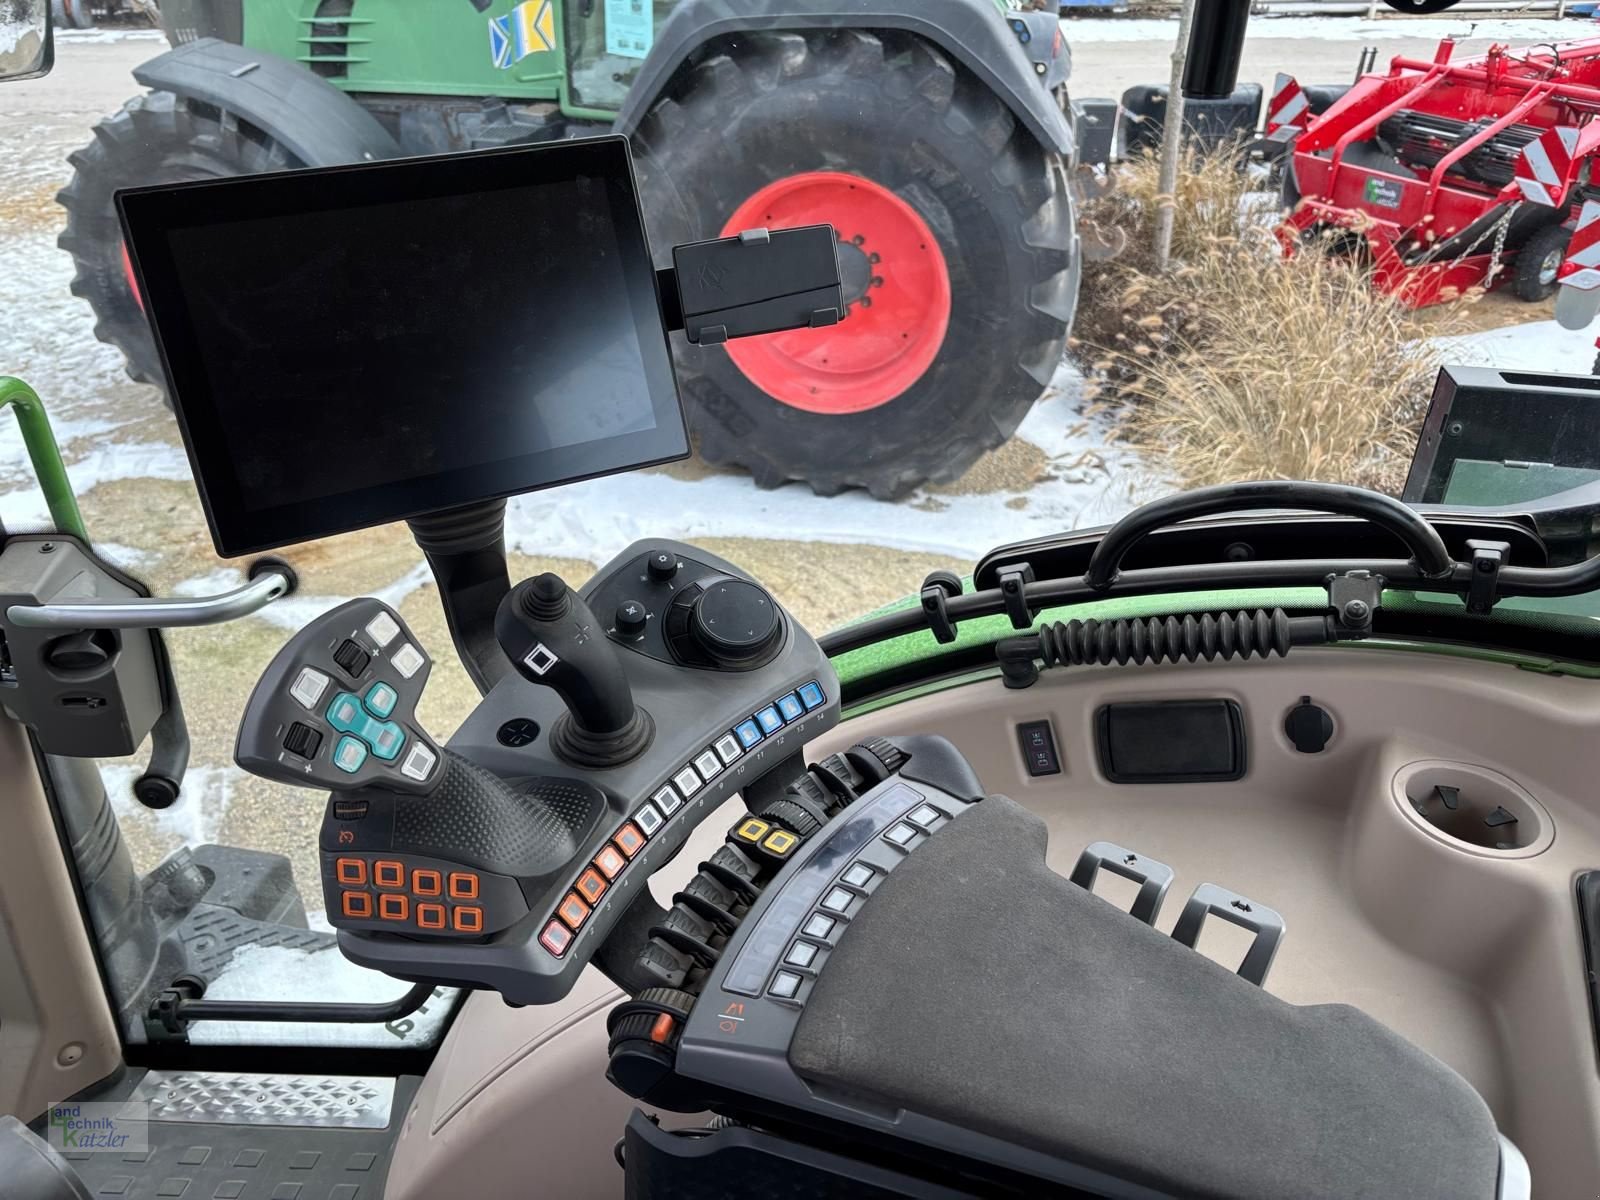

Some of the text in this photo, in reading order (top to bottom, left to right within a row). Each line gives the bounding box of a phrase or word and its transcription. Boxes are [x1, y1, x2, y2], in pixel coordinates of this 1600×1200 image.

[736, 764, 745, 776] 10
[756, 751, 764, 761] 11
[776, 735, 785, 746] 12
[796, 723, 805, 733] 13
[816, 712, 825, 721] 14
